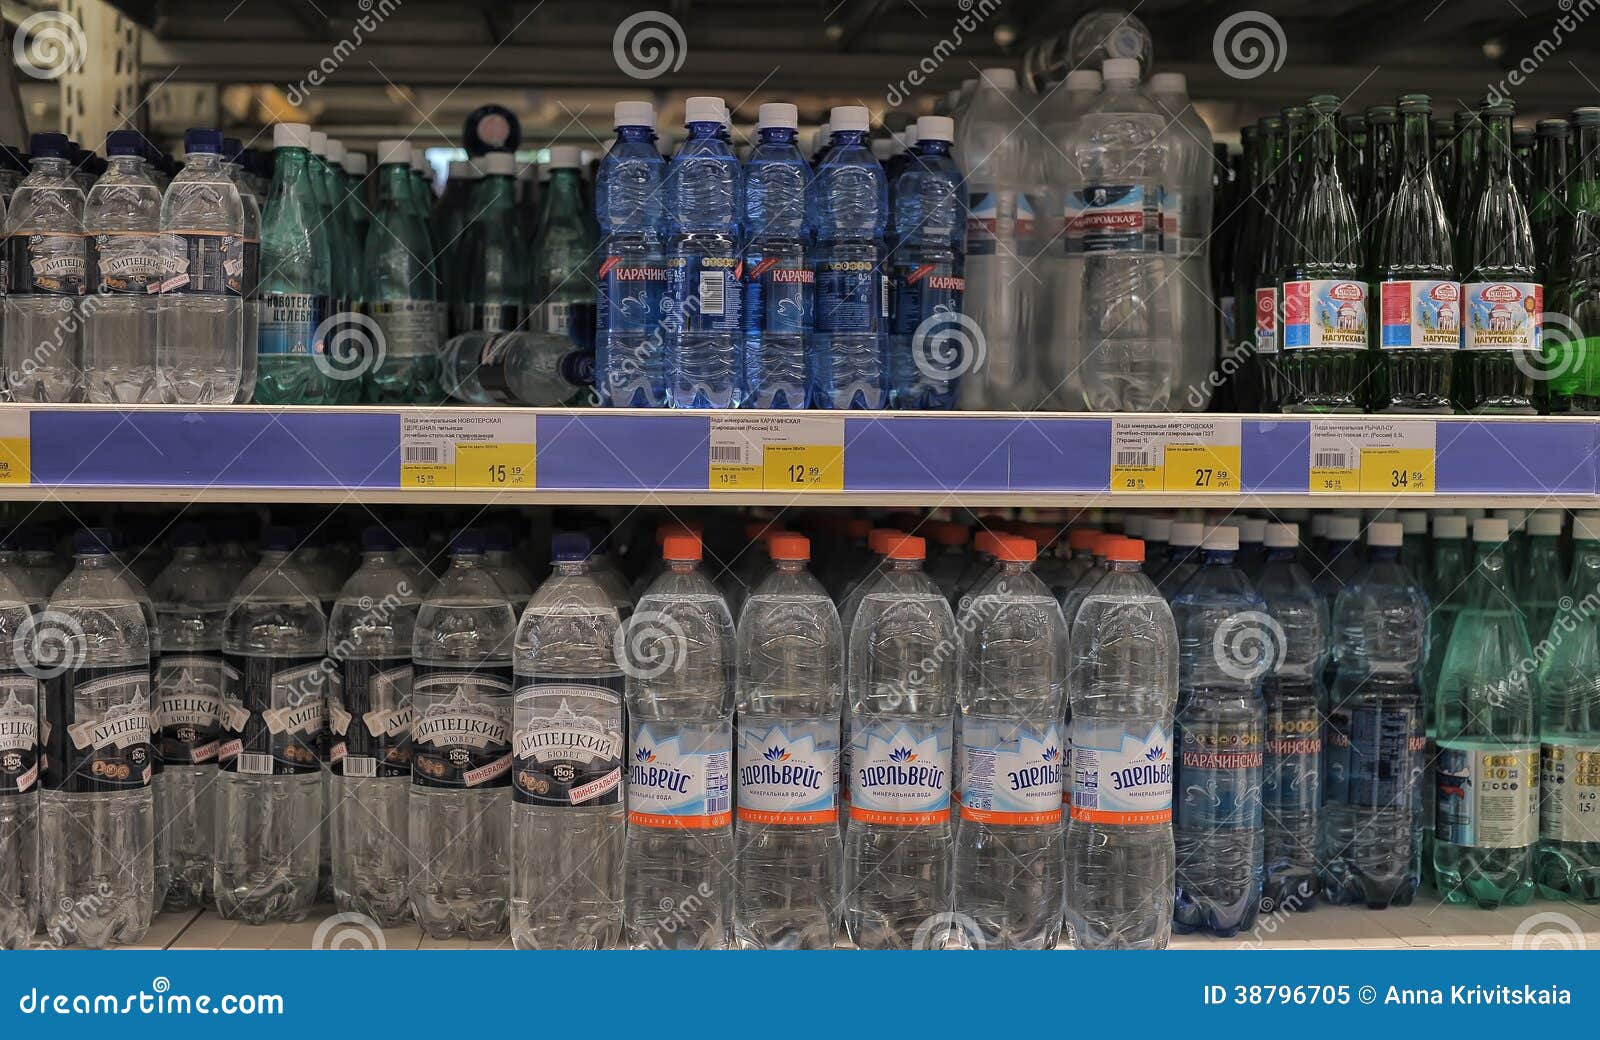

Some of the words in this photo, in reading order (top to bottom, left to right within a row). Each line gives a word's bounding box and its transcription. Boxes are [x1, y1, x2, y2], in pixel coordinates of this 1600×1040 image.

[616, 268, 667, 281] КАРАЧИНС
[773, 269, 815, 282] КАРАЧИН
[929, 276, 965, 290] КАРАЧИ
[488, 465, 506, 482] 15
[788, 465, 804, 482] 12
[1195, 469, 1212, 486] 27
[1391, 470, 1407, 487] 34
[1324, 480, 1333, 488] 36
[162, 699, 220, 715] ПЕЦКИ
[288, 705, 321, 728] ЛИПЕ
[418, 717, 505, 741] ЛИПЕЦКИЙ
[520, 732, 612, 756] ЛИПЕЦКИЙ
[3, 758, 22, 767] 1805
[449, 752, 470, 763] 1805
[547, 750, 581, 759] БЮВЕТ
[1183, 751, 1264, 768] КАРАЧИНСКАЯ
[553, 770, 575, 780] 1805
[572, 771, 621, 800] МИНЕРАЛЬНАЯ
